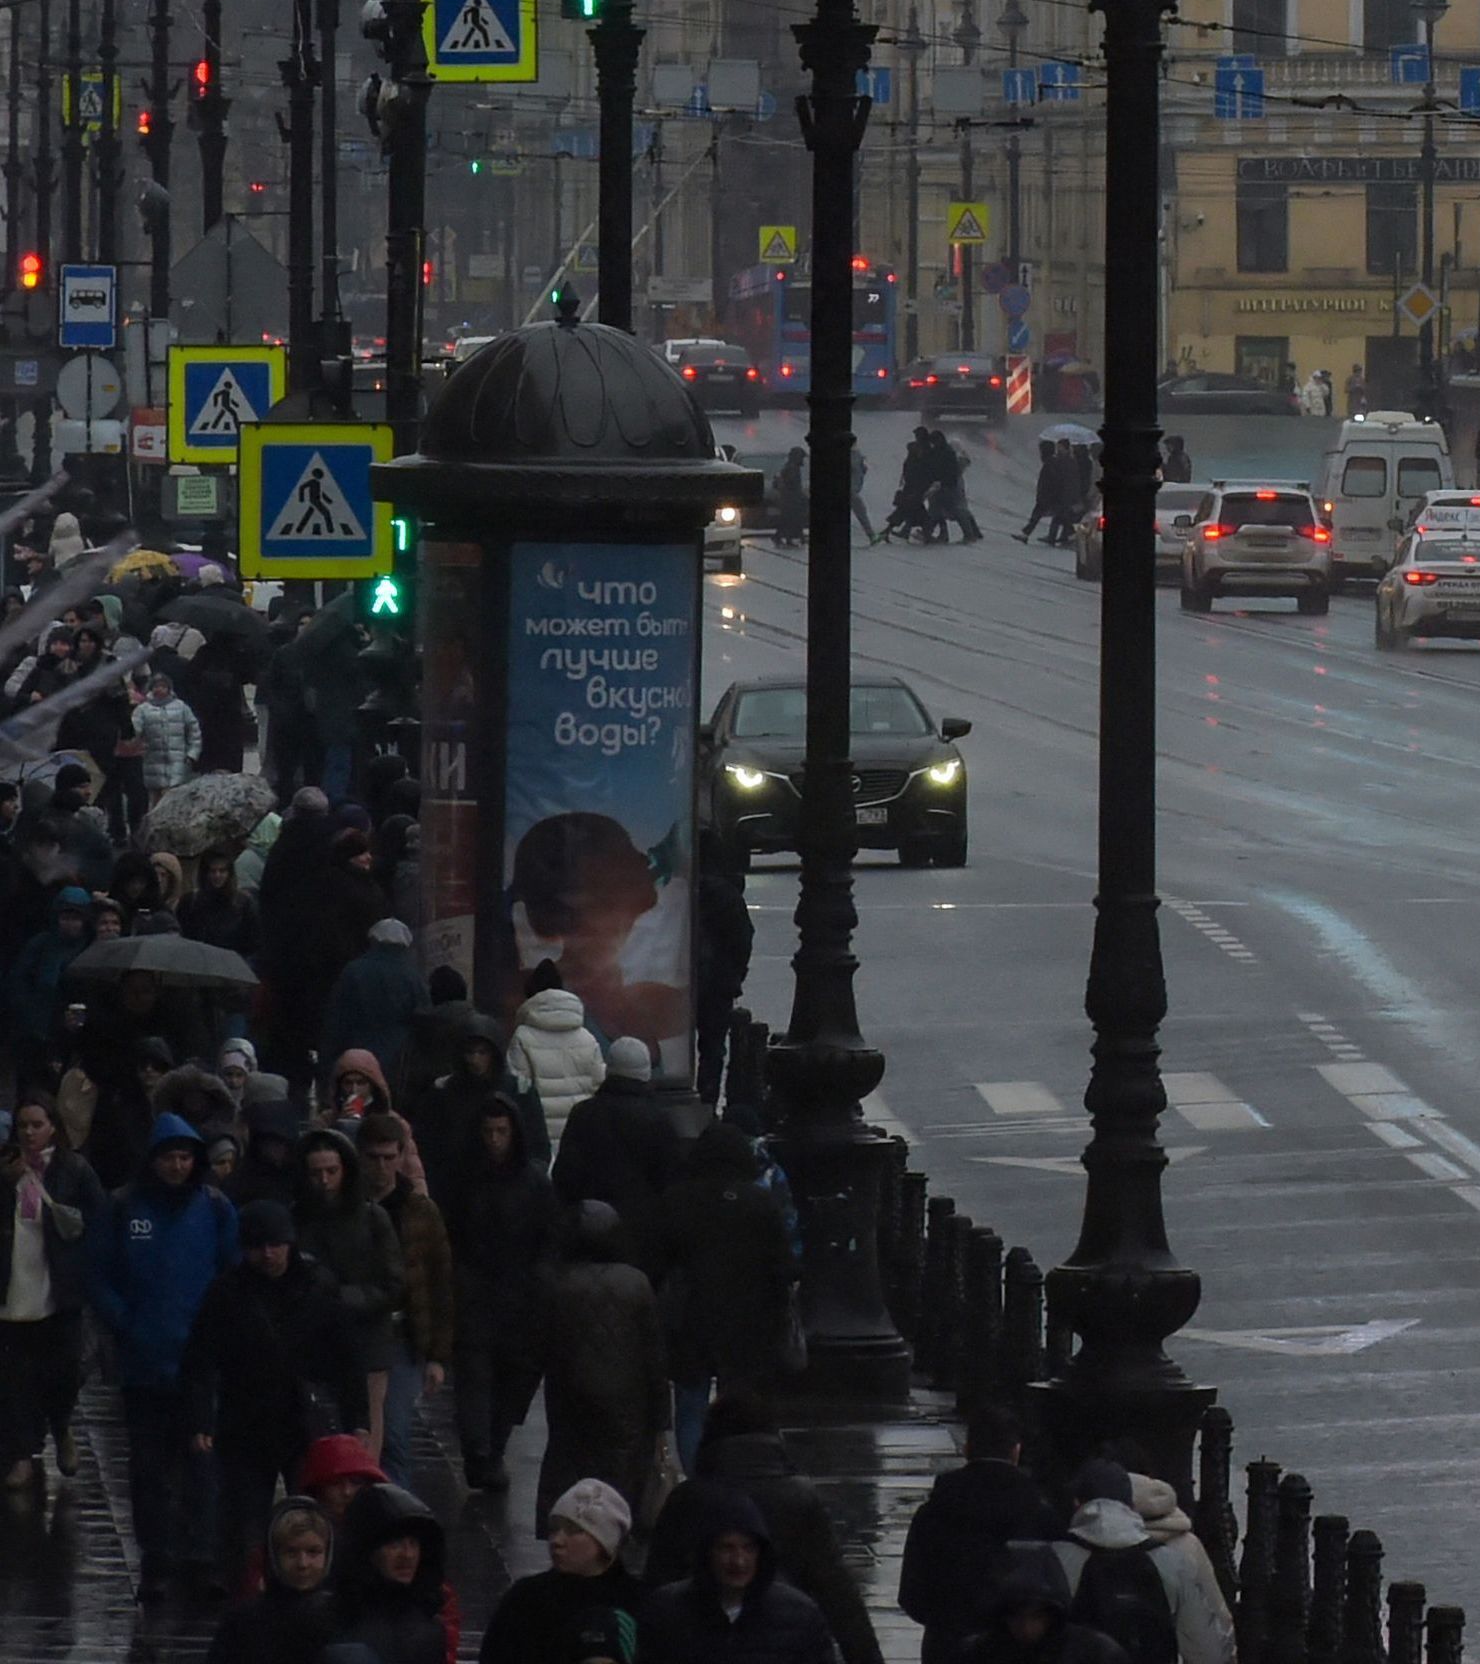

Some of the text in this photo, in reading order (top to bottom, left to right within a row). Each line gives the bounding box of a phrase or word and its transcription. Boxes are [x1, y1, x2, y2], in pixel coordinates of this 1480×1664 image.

[577, 580, 658, 606] что
[525, 617, 631, 636] может
[539, 647, 659, 681] лучше
[554, 710, 662, 756] воды?
